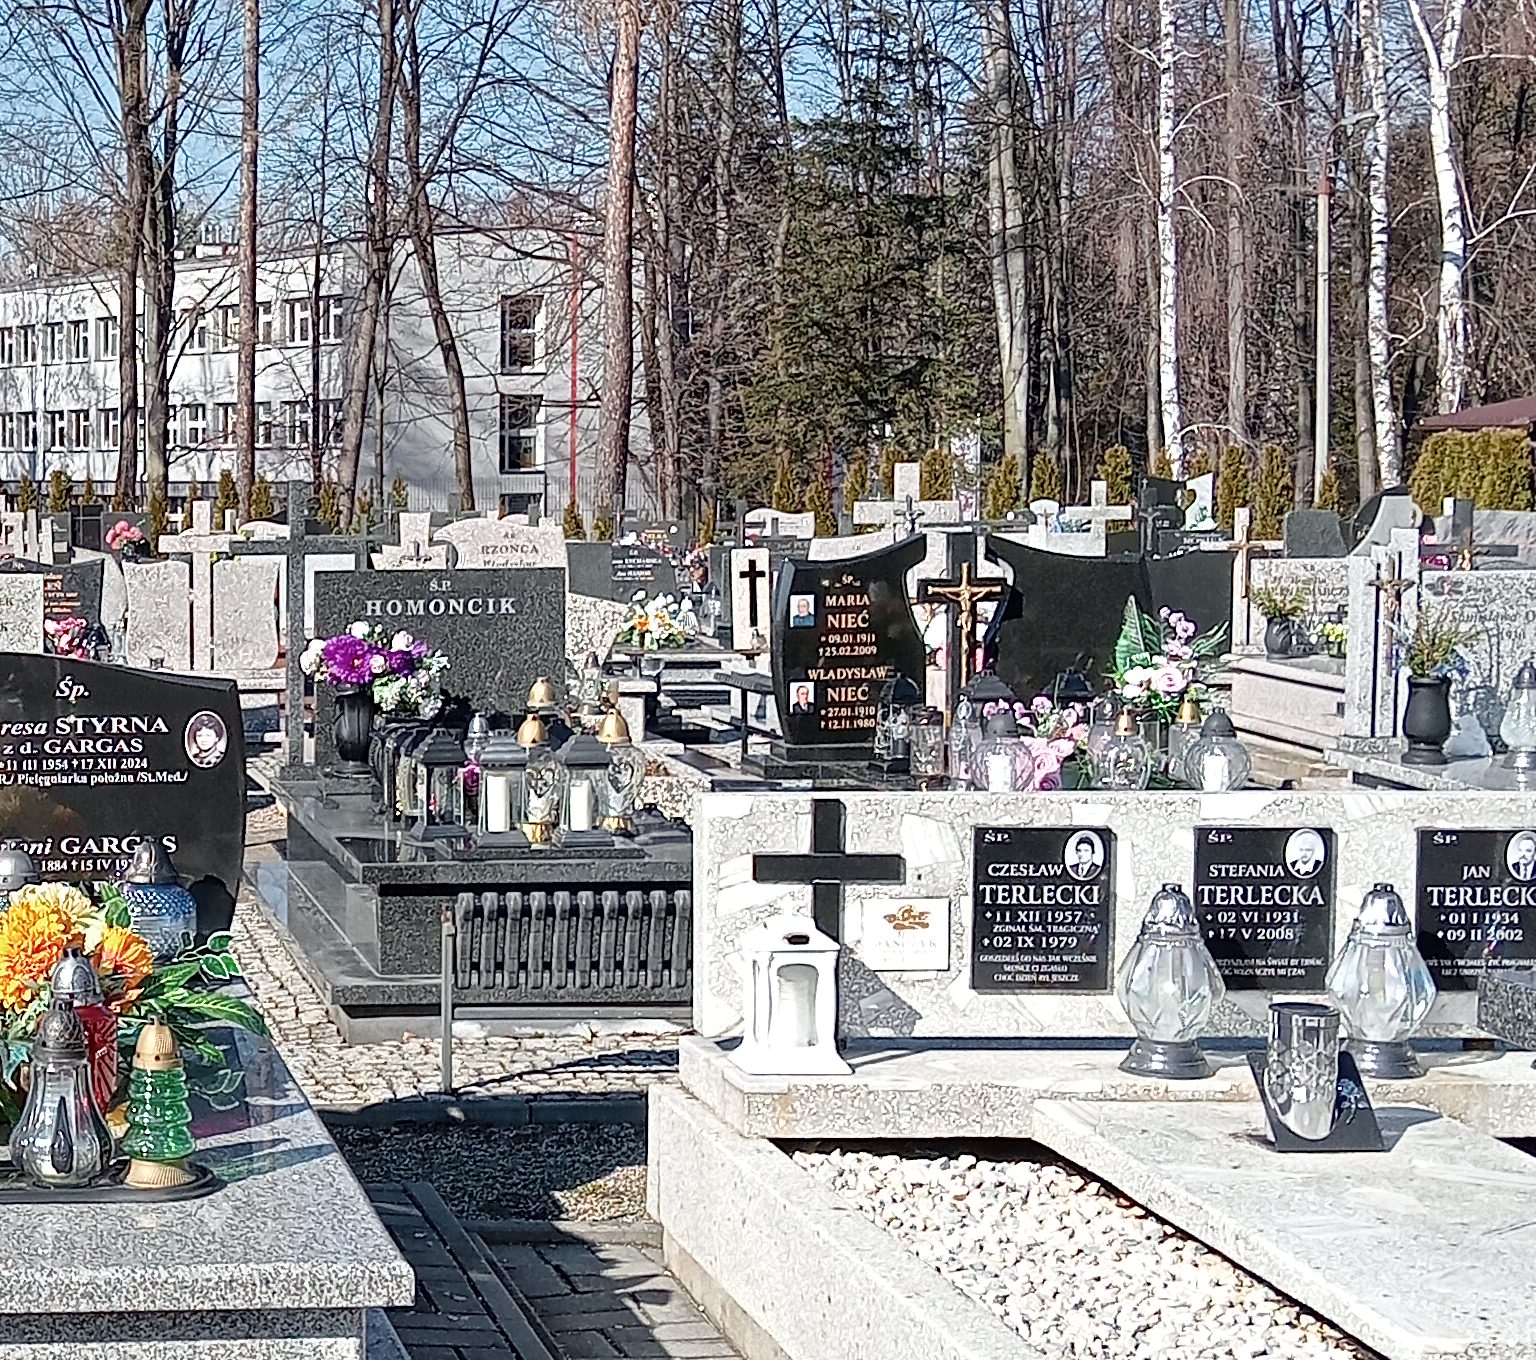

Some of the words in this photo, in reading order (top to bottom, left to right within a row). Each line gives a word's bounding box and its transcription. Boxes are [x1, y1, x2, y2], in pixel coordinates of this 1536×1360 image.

[365, 597, 516, 617] HOMONCIK
[825, 594, 871, 607] MARIA
[827, 610, 870, 629] NIEĆ
[56, 676, 90, 703] Śp.
[827, 682, 869, 702] NIEĆ
[56, 716, 170, 735] STYRNA
[2, 744, 14, 755] z
[20, 740, 38, 755] d.
[44, 738, 143, 755] GARGAS
[42, 758, 69, 771] 1954
[97, 758, 117, 771] XII
[120, 757, 148, 770] 2024
[60, 835, 178, 855] GARGS
[40, 859, 67, 872] 1884
[97, 859, 112, 871] IV
[987, 863, 1064, 877] CZESŁAW
[1208, 864, 1285, 878] STEFANIA
[1461, 865, 1491, 881] JAN
[979, 884, 1100, 905] TERLECKI
[1197, 885, 1325, 906] TERLECKA
[995, 910, 1011, 923] 11
[1017, 910, 1041, 923] XII
[1046, 910, 1083, 924] 1957
[1217, 911, 1237, 924] 02
[1241, 911, 1259, 924] VI
[1265, 911, 1299, 924] 1931
[1448, 912, 1466, 925] 01
[1484, 911, 1519, 925] 1934
[1220, 927, 1237, 940] 17
[1241, 927, 1253, 940] V
[1256, 926, 1295, 940] 2008
[1446, 928, 1467, 941] 09
[992, 935, 1013, 948] 02
[1017, 935, 1035, 948] IX
[1041, 935, 1078, 949] 1979
